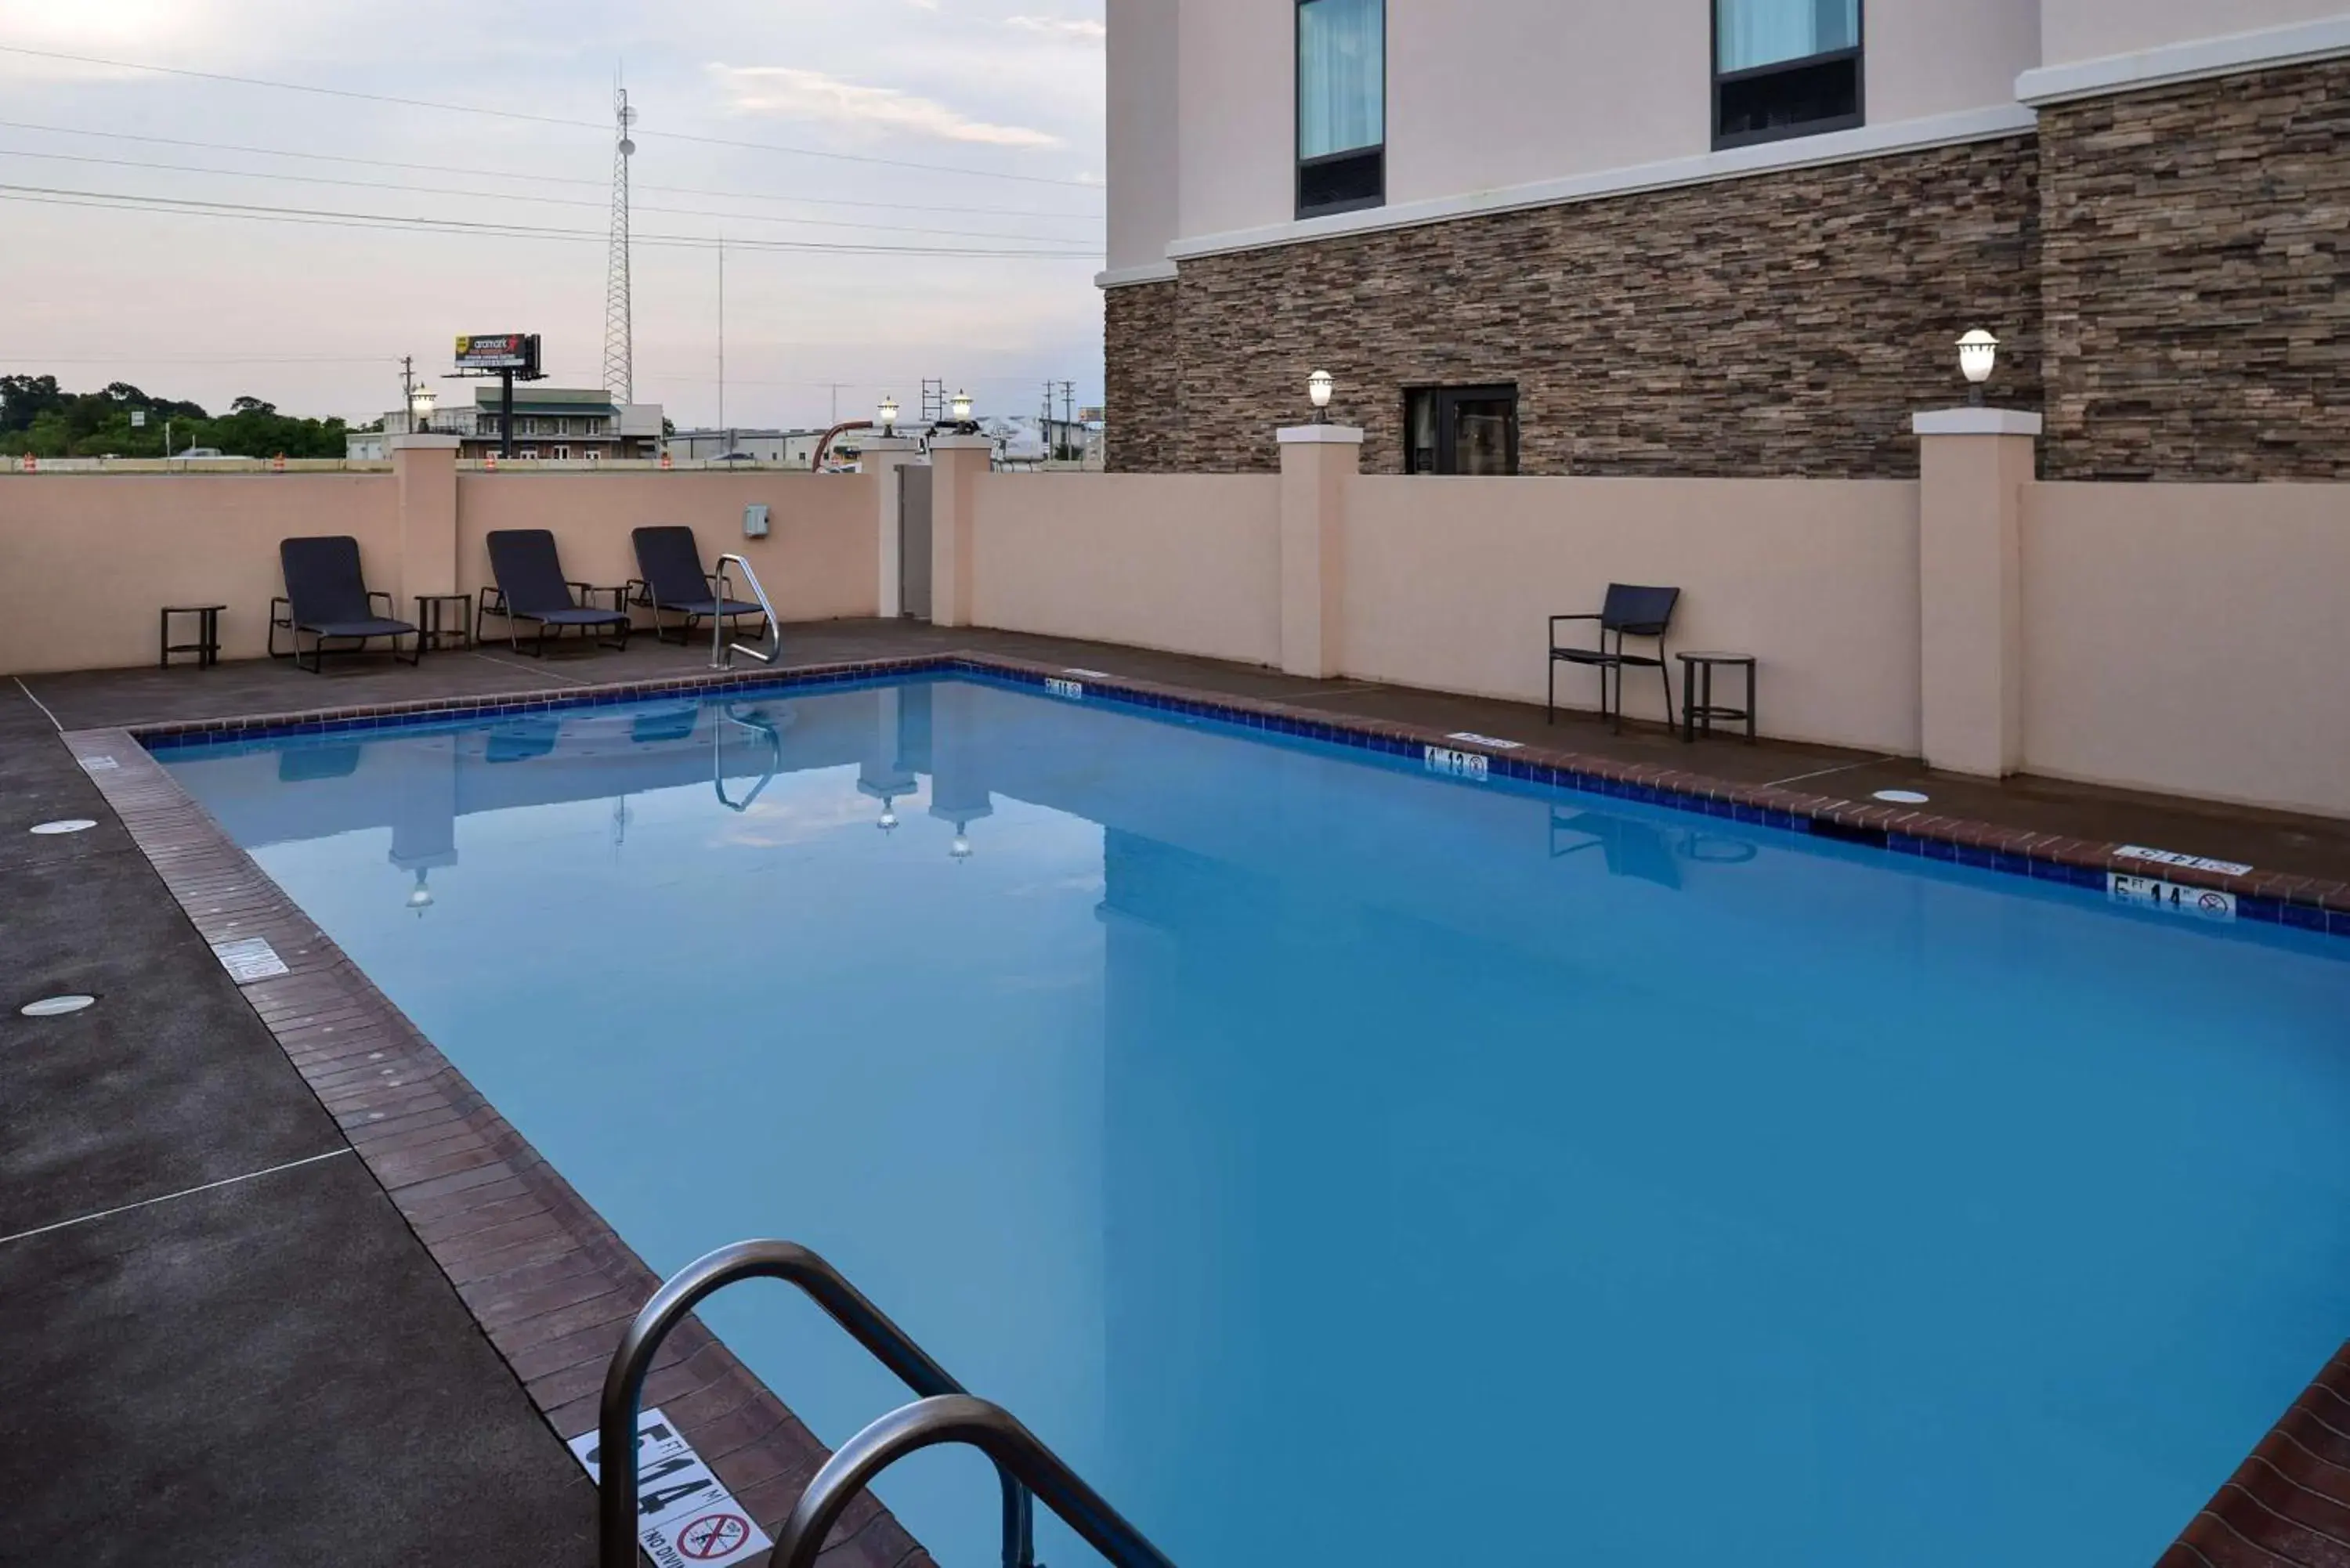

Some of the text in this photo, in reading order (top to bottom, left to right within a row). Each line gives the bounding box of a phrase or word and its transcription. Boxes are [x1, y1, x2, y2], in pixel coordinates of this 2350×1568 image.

[2131, 877, 2144, 891] FT
[660, 1440, 683, 1454] FT
[702, 1488, 723, 1501] M
[643, 1530, 667, 1548] NO
